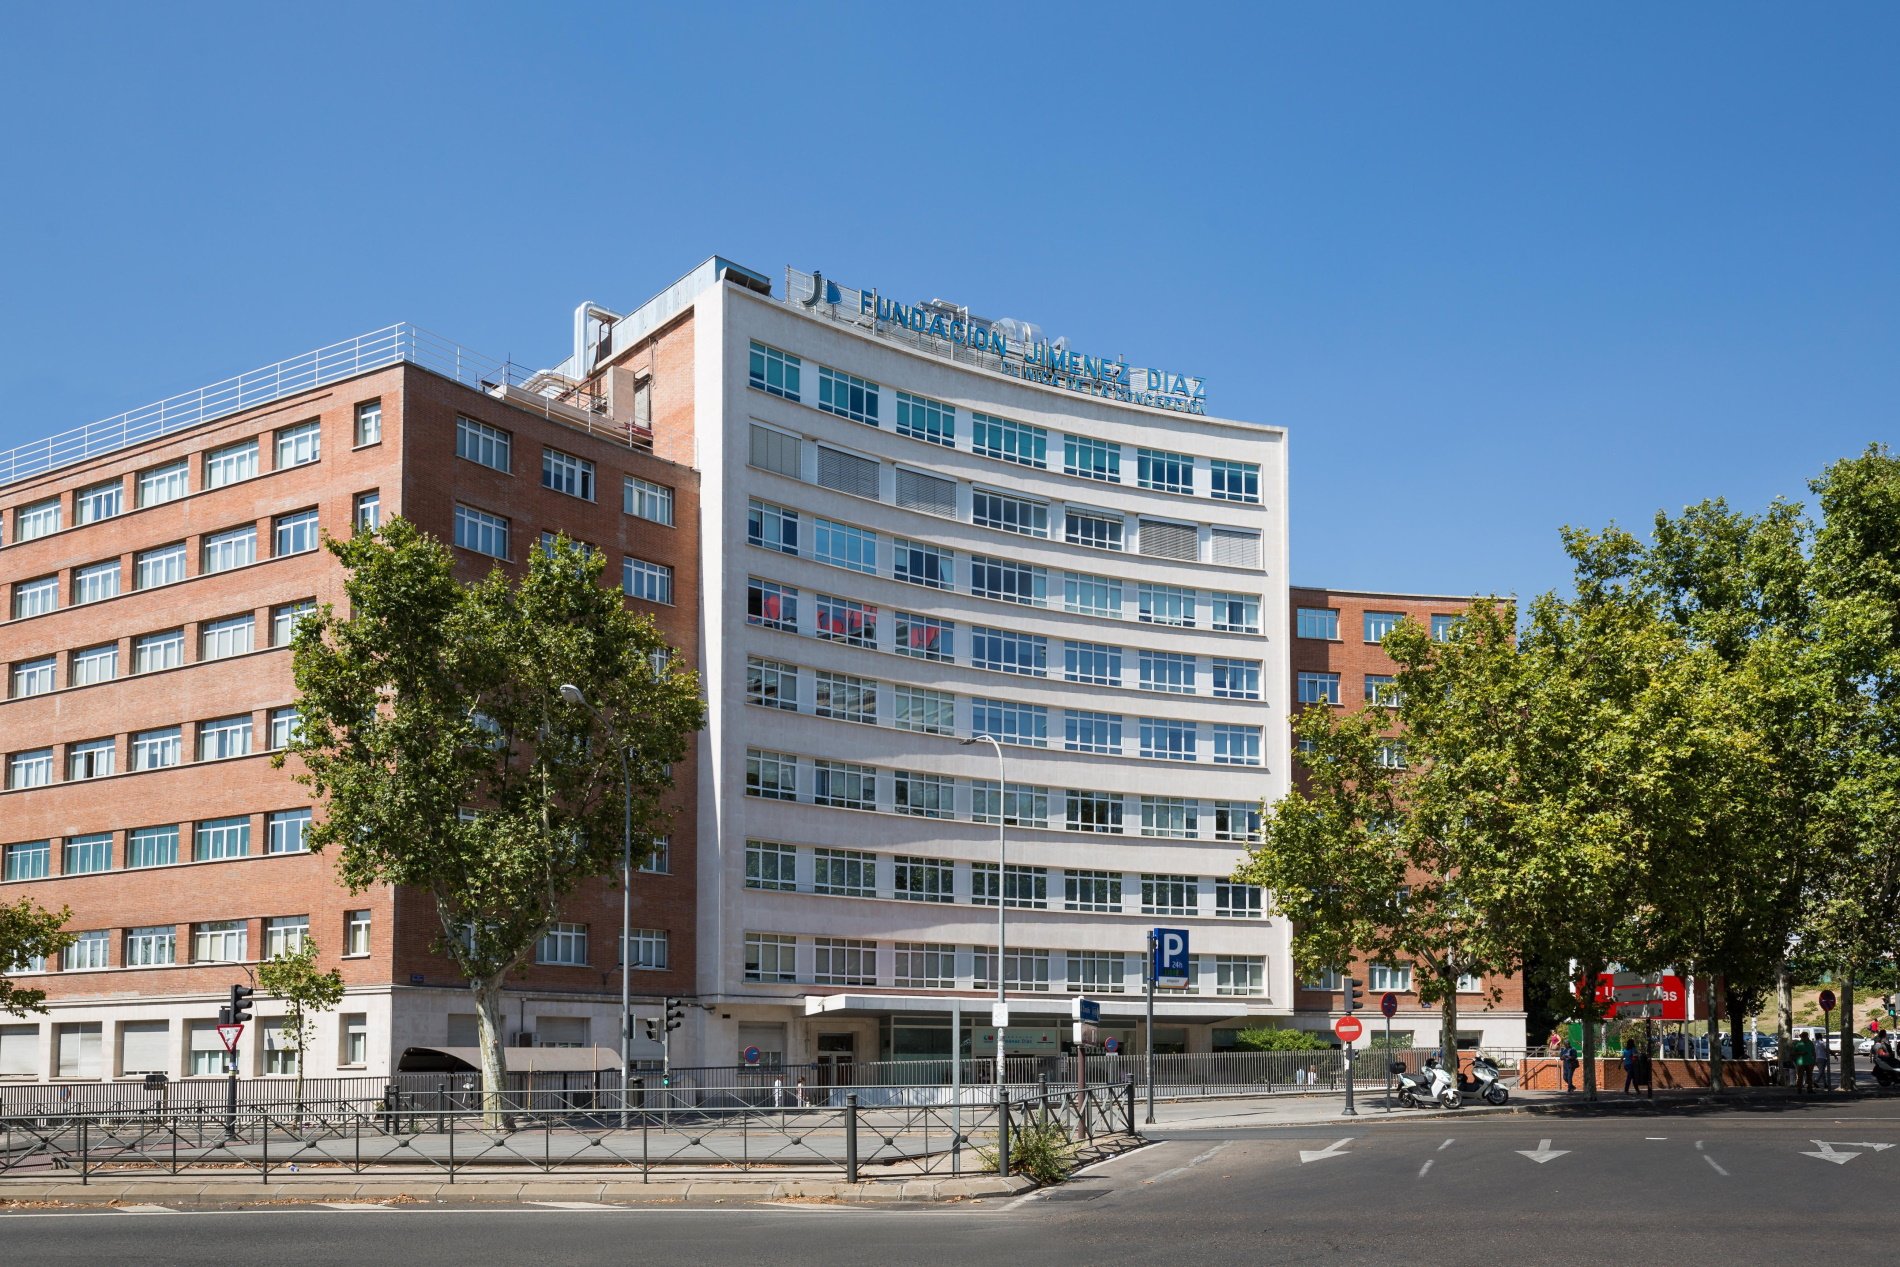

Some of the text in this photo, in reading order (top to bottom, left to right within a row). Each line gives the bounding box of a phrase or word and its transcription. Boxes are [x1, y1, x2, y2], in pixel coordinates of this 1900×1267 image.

[859, 289, 1208, 399] FUNDACION JIMENEZ DIAZ
[1065, 376, 1084, 392] DE
[1164, 933, 1184, 968] P
[1172, 960, 1183, 969] 24h
